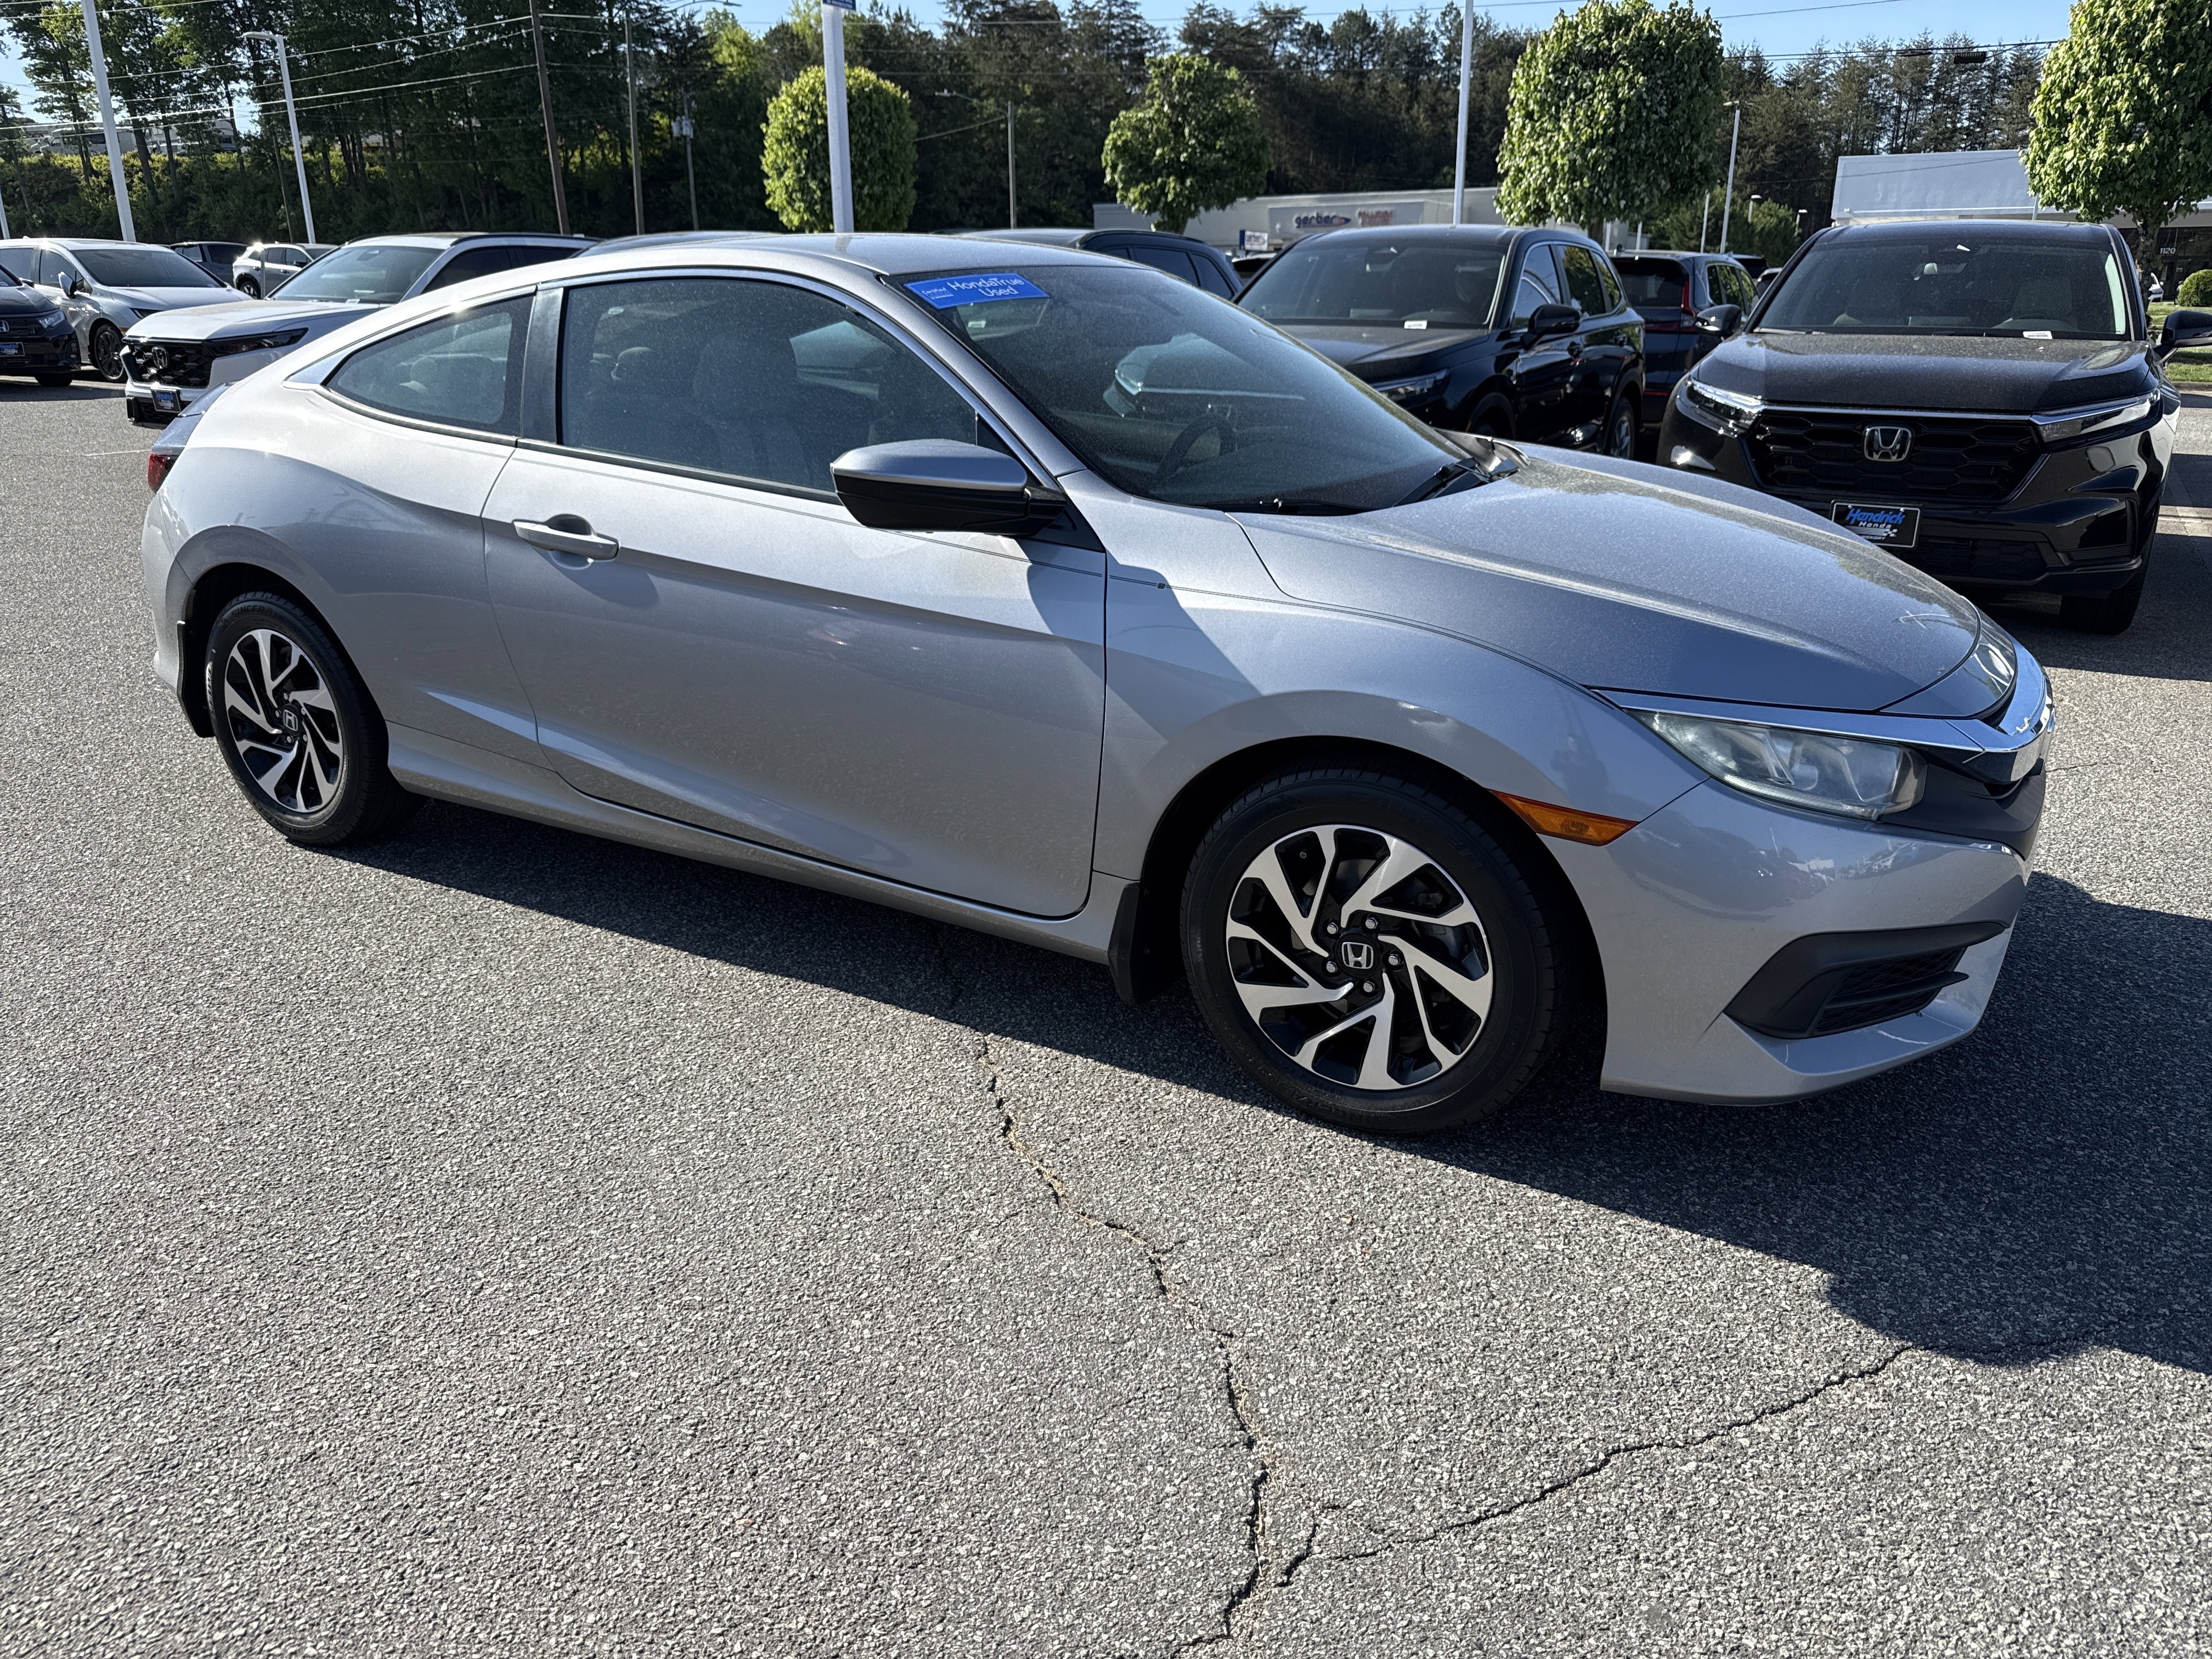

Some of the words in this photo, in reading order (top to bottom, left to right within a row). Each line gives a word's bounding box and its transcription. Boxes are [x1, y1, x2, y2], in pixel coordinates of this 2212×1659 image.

[1295, 213, 1338, 228] gerber
[947, 278, 1024, 291] HondaTrue
[978, 285, 1019, 297] Used
[1846, 509, 1905, 524] Hendrick
